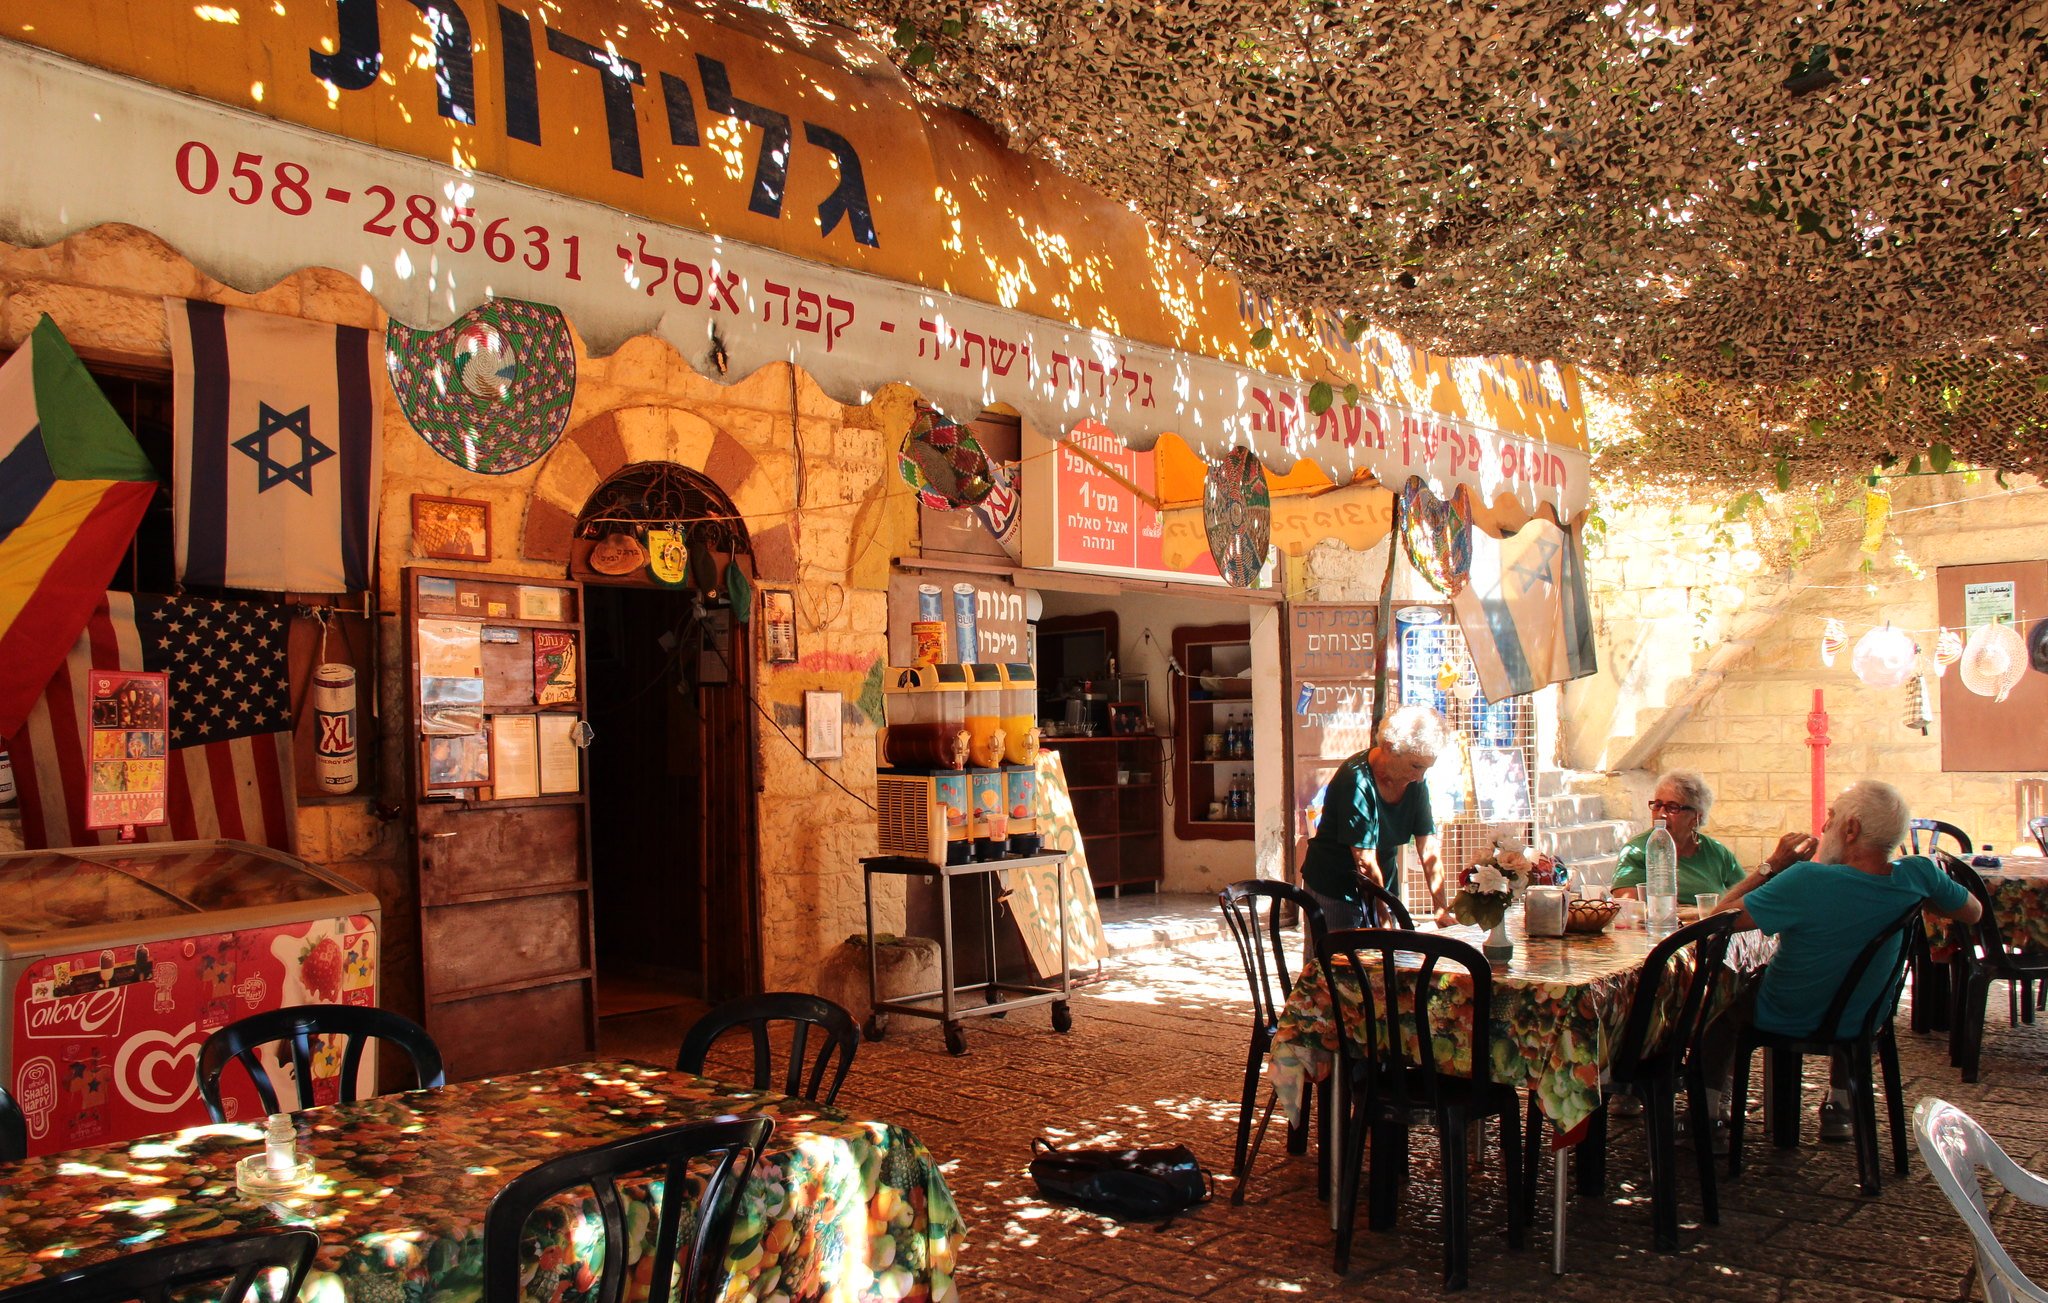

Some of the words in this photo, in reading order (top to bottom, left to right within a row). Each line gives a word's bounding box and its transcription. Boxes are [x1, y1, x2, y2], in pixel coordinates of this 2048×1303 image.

[309, 0, 881, 249] גלידות
[175, 141, 582, 281] 058-285631
[616, 233, 740, 315] אסלי
[763, 279, 855, 352] קפה
[918, 318, 1032, 382] ושתיה
[1050, 350, 1156, 409] גלידות
[1500, 444, 1567, 490] חומוס
[1068, 513, 1101, 531] סאלח
[1082, 536, 1115, 550] ונזהה
[1105, 517, 1128, 534] אצל
[977, 589, 1022, 622] חנות
[1308, 633, 1374, 651] פצוחים
[320, 715, 355, 753] XL
